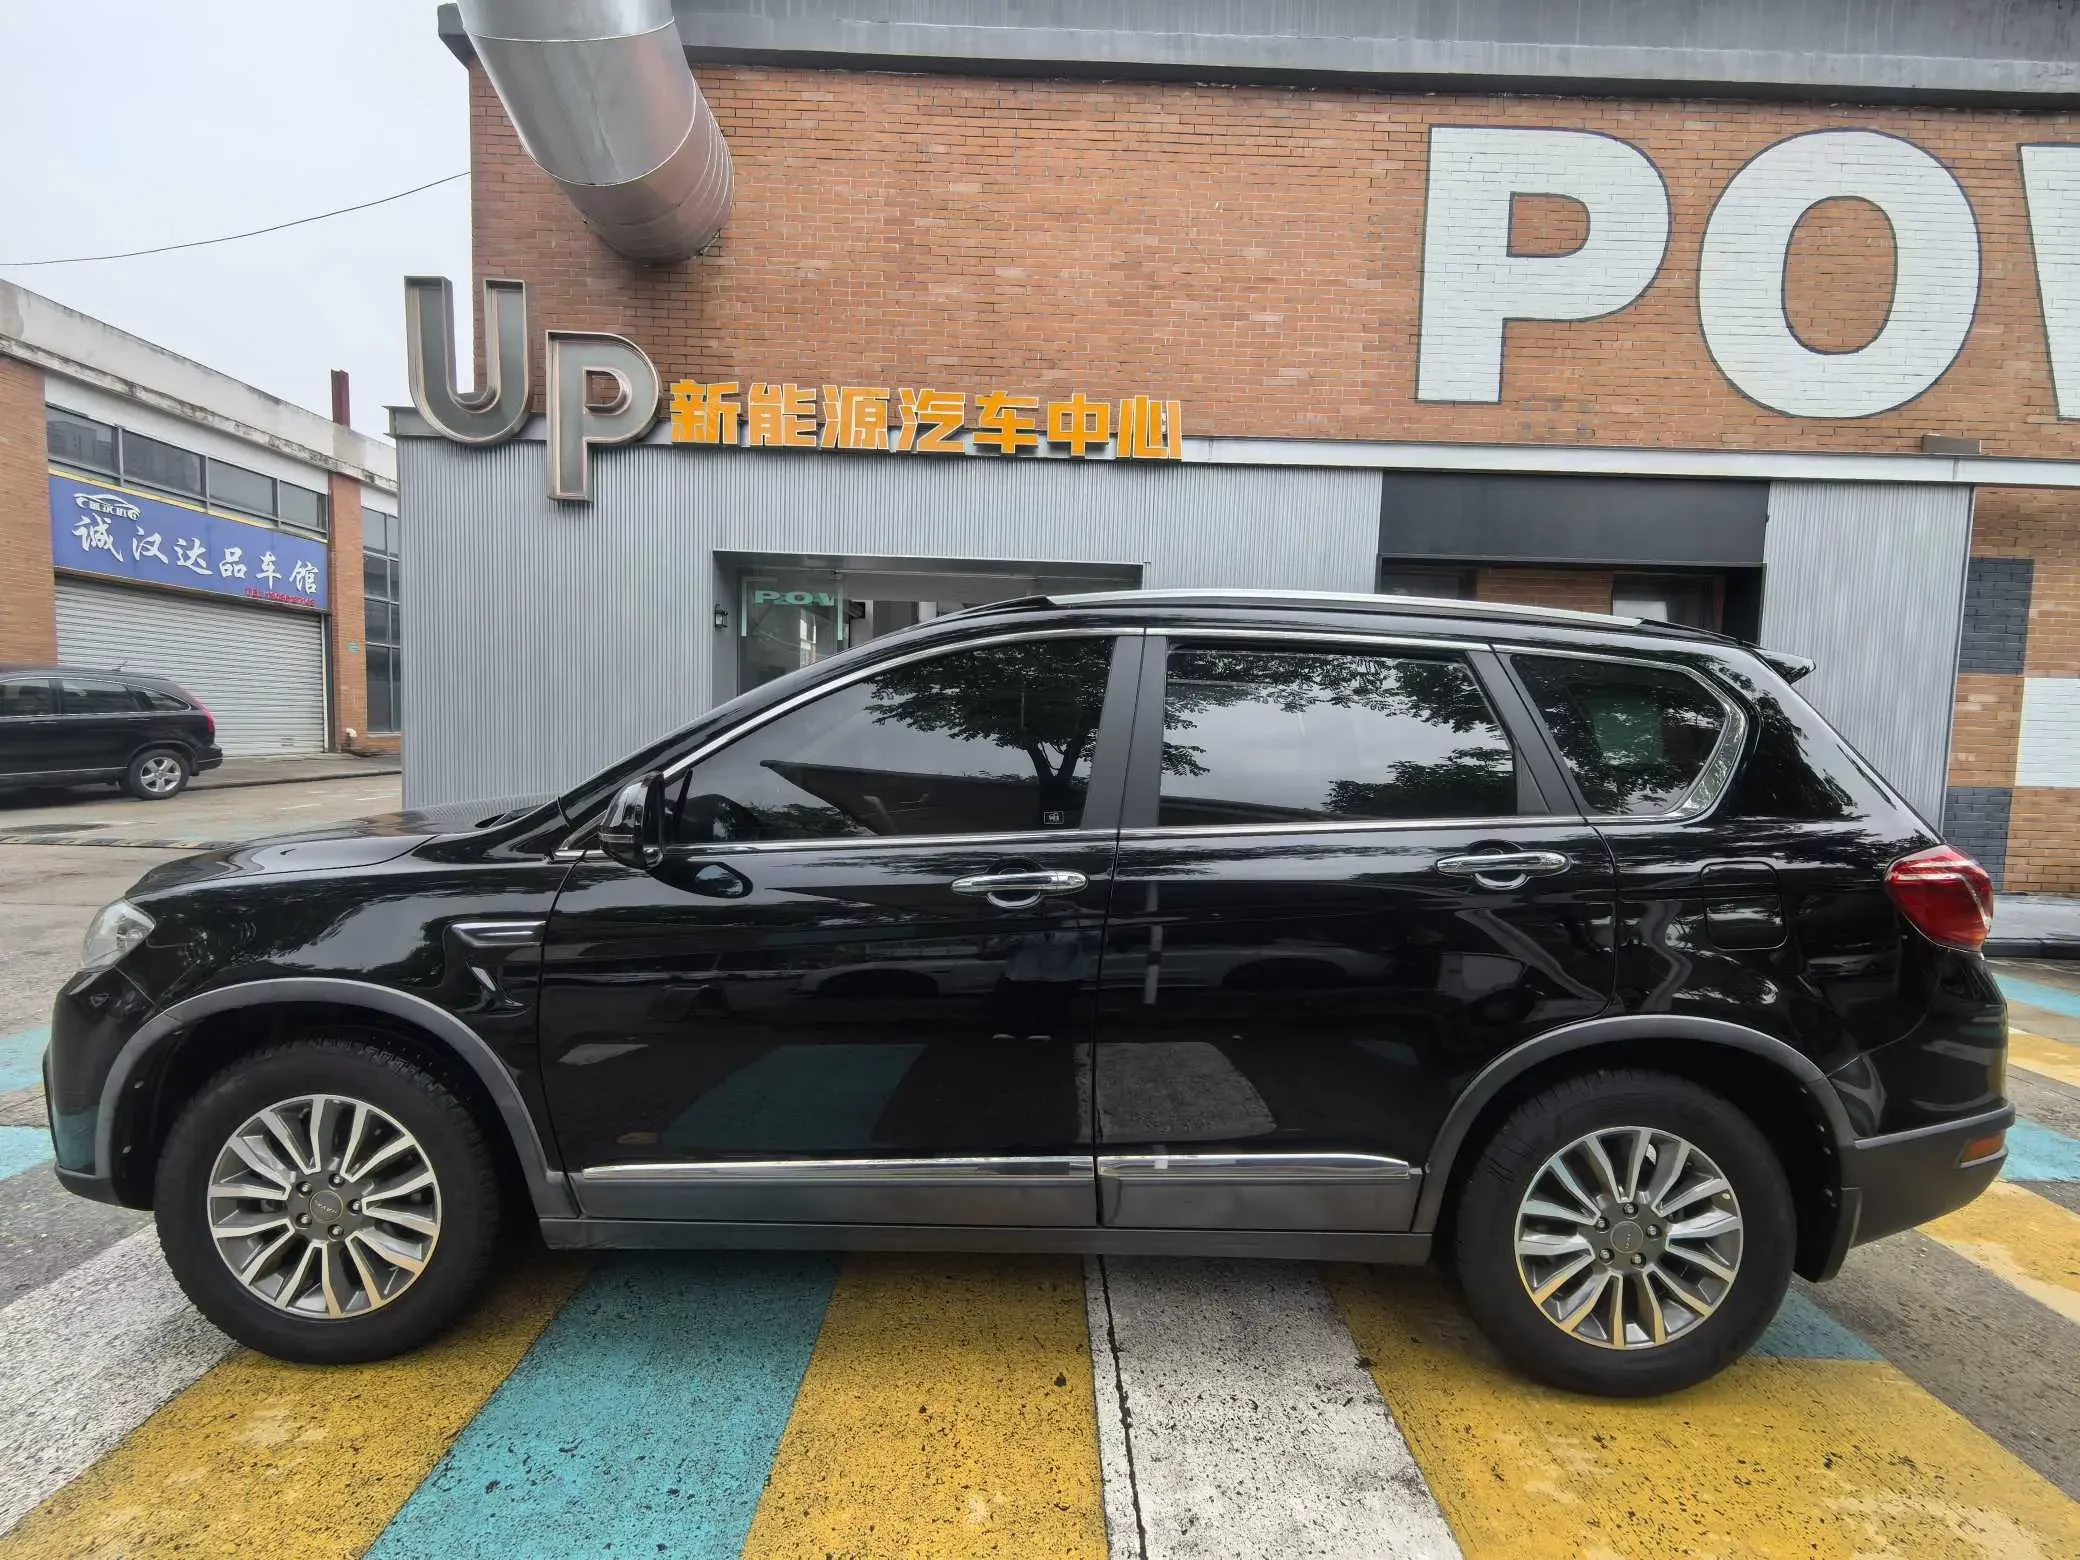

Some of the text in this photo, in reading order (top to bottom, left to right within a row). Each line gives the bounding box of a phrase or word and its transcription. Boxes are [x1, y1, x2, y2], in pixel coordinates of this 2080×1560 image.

[1415, 125, 2080, 420] PO
[403, 275, 660, 502] UP
[669, 379, 1183, 460] 新能源汽车中心
[72, 513, 319, 594] 诚汉达品车馆
